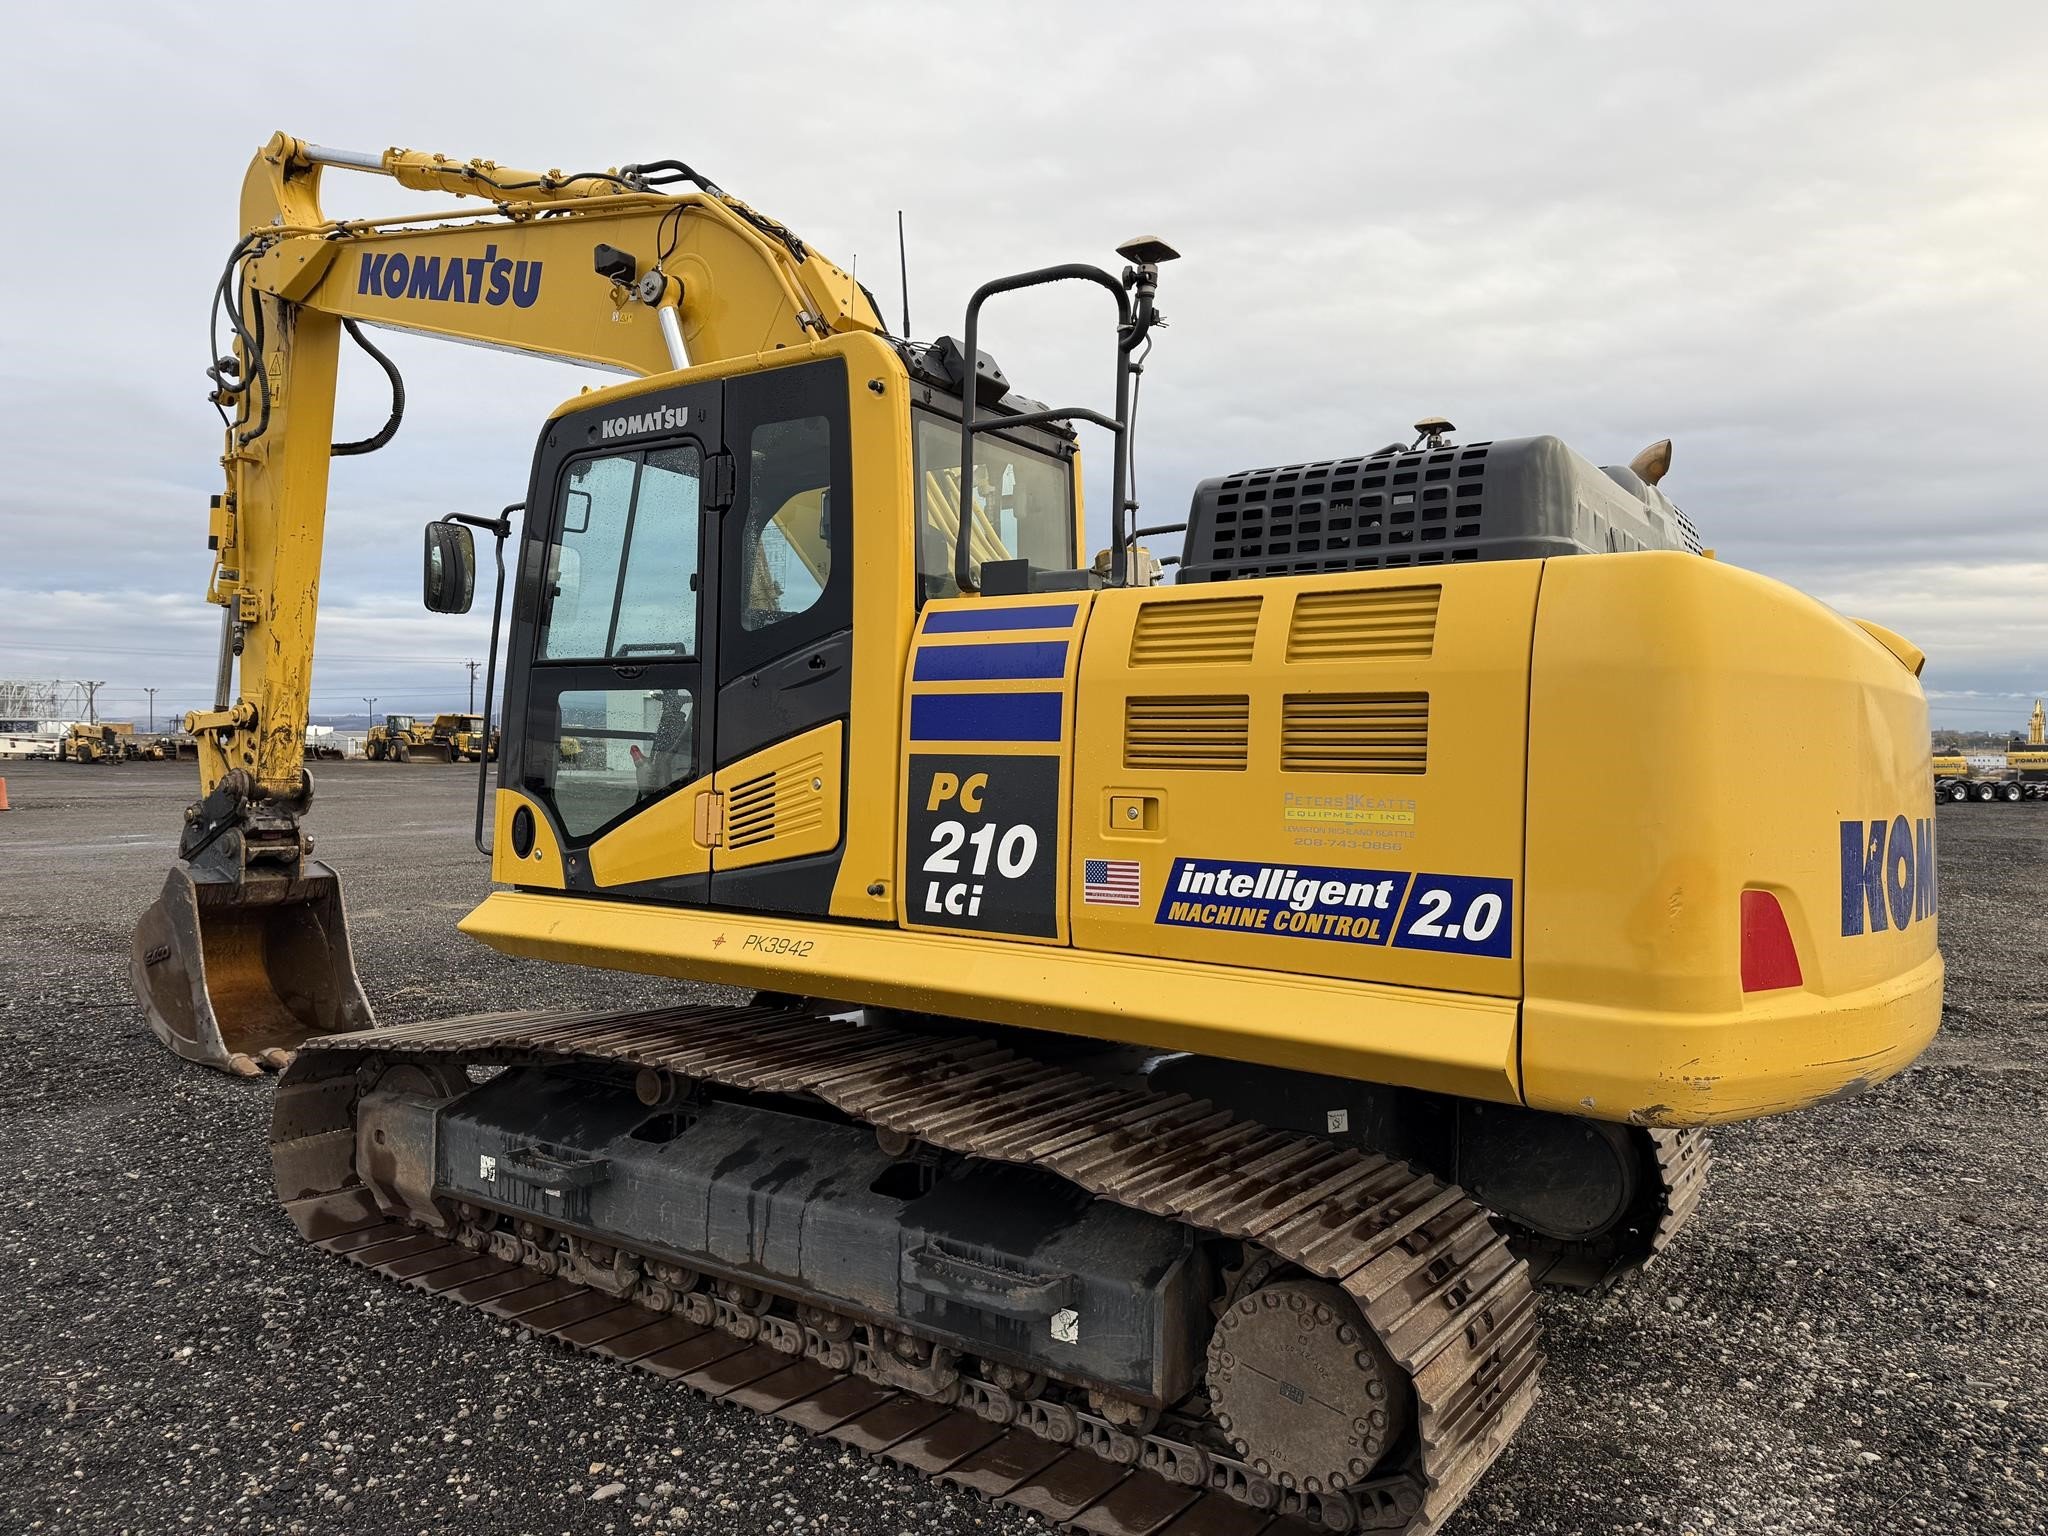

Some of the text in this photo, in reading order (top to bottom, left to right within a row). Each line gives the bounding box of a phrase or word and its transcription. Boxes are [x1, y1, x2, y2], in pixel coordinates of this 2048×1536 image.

[357, 244, 543, 308] KOMATSU
[602, 404, 688, 438] KOMATSU
[927, 772, 989, 813] PC
[1287, 810, 1411, 822] EQUIPMENT INC.
[922, 820, 1038, 879] 210
[925, 881, 984, 916] LCi
[1177, 863, 1503, 941] intelligent 2.0
[1168, 902, 1380, 939] MACHINE CONTROL
[742, 934, 814, 957] PK3942
